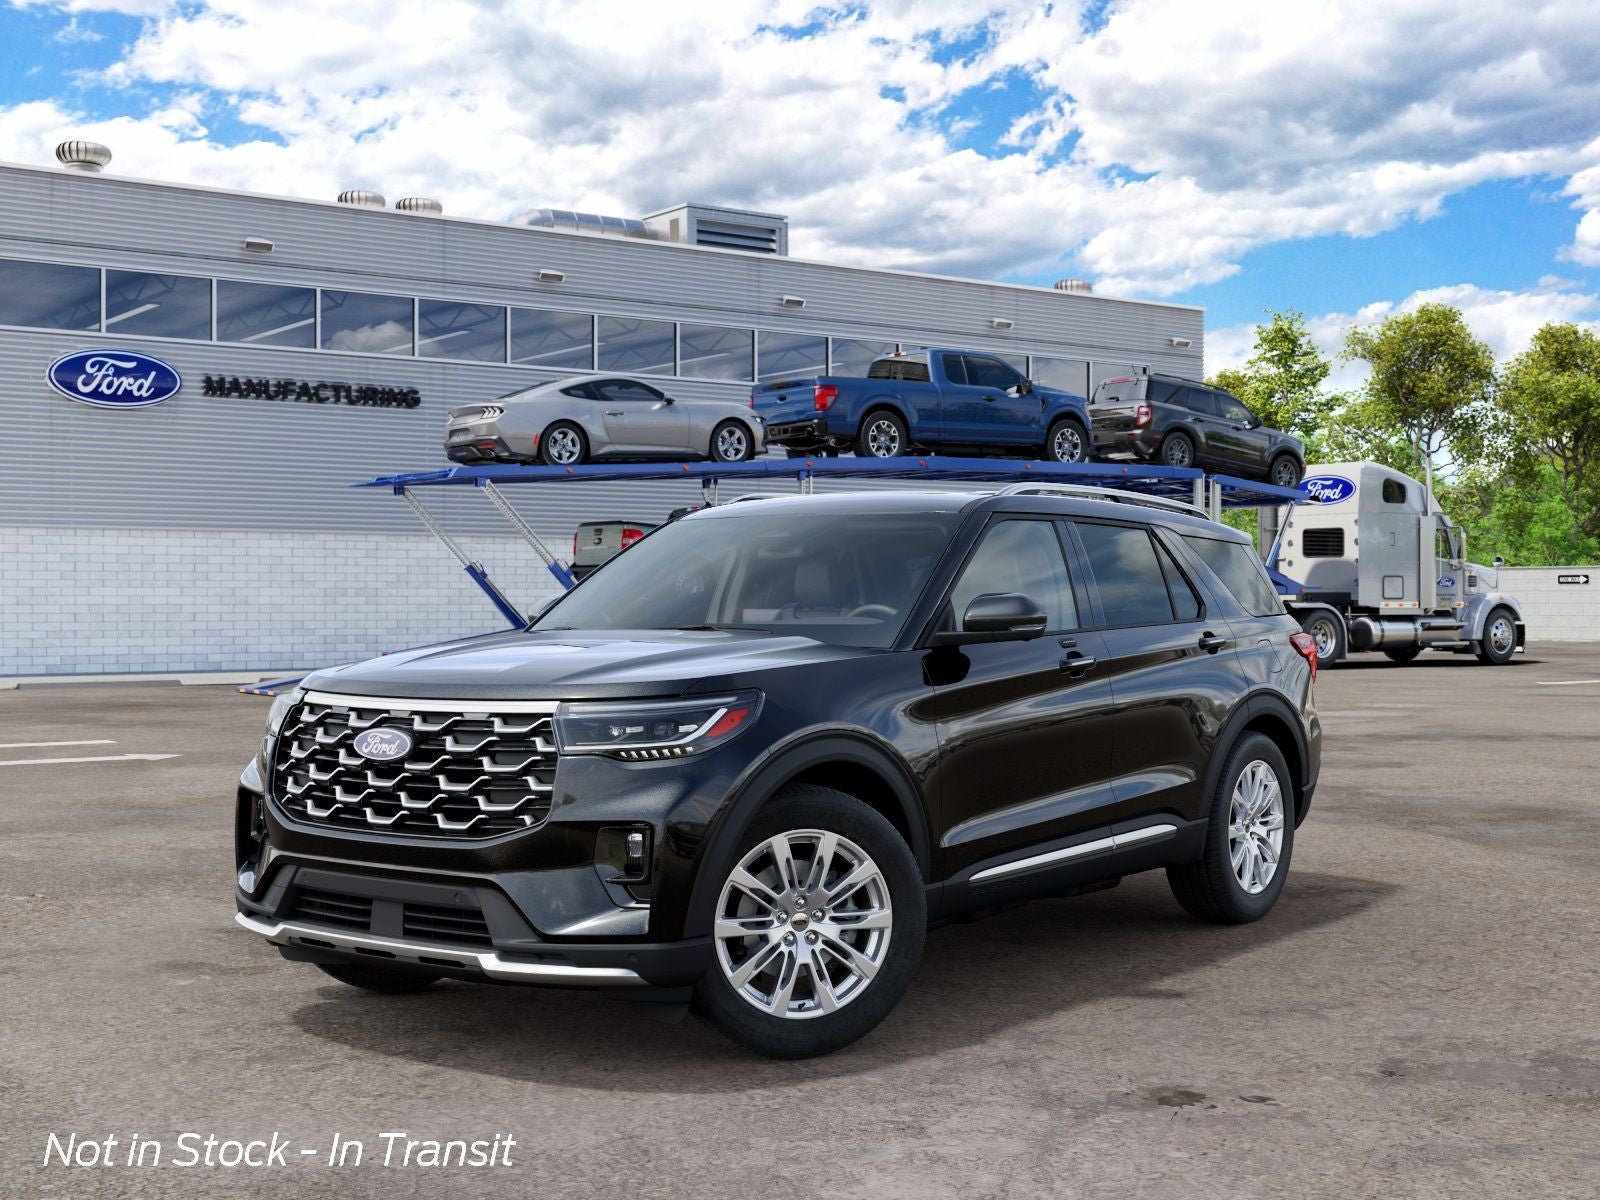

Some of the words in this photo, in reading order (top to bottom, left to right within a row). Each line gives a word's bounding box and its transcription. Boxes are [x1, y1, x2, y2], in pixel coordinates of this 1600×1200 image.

[76, 356, 157, 398] Ford
[203, 373, 421, 409] MANUFACTURING
[362, 733, 400, 755] Ford
